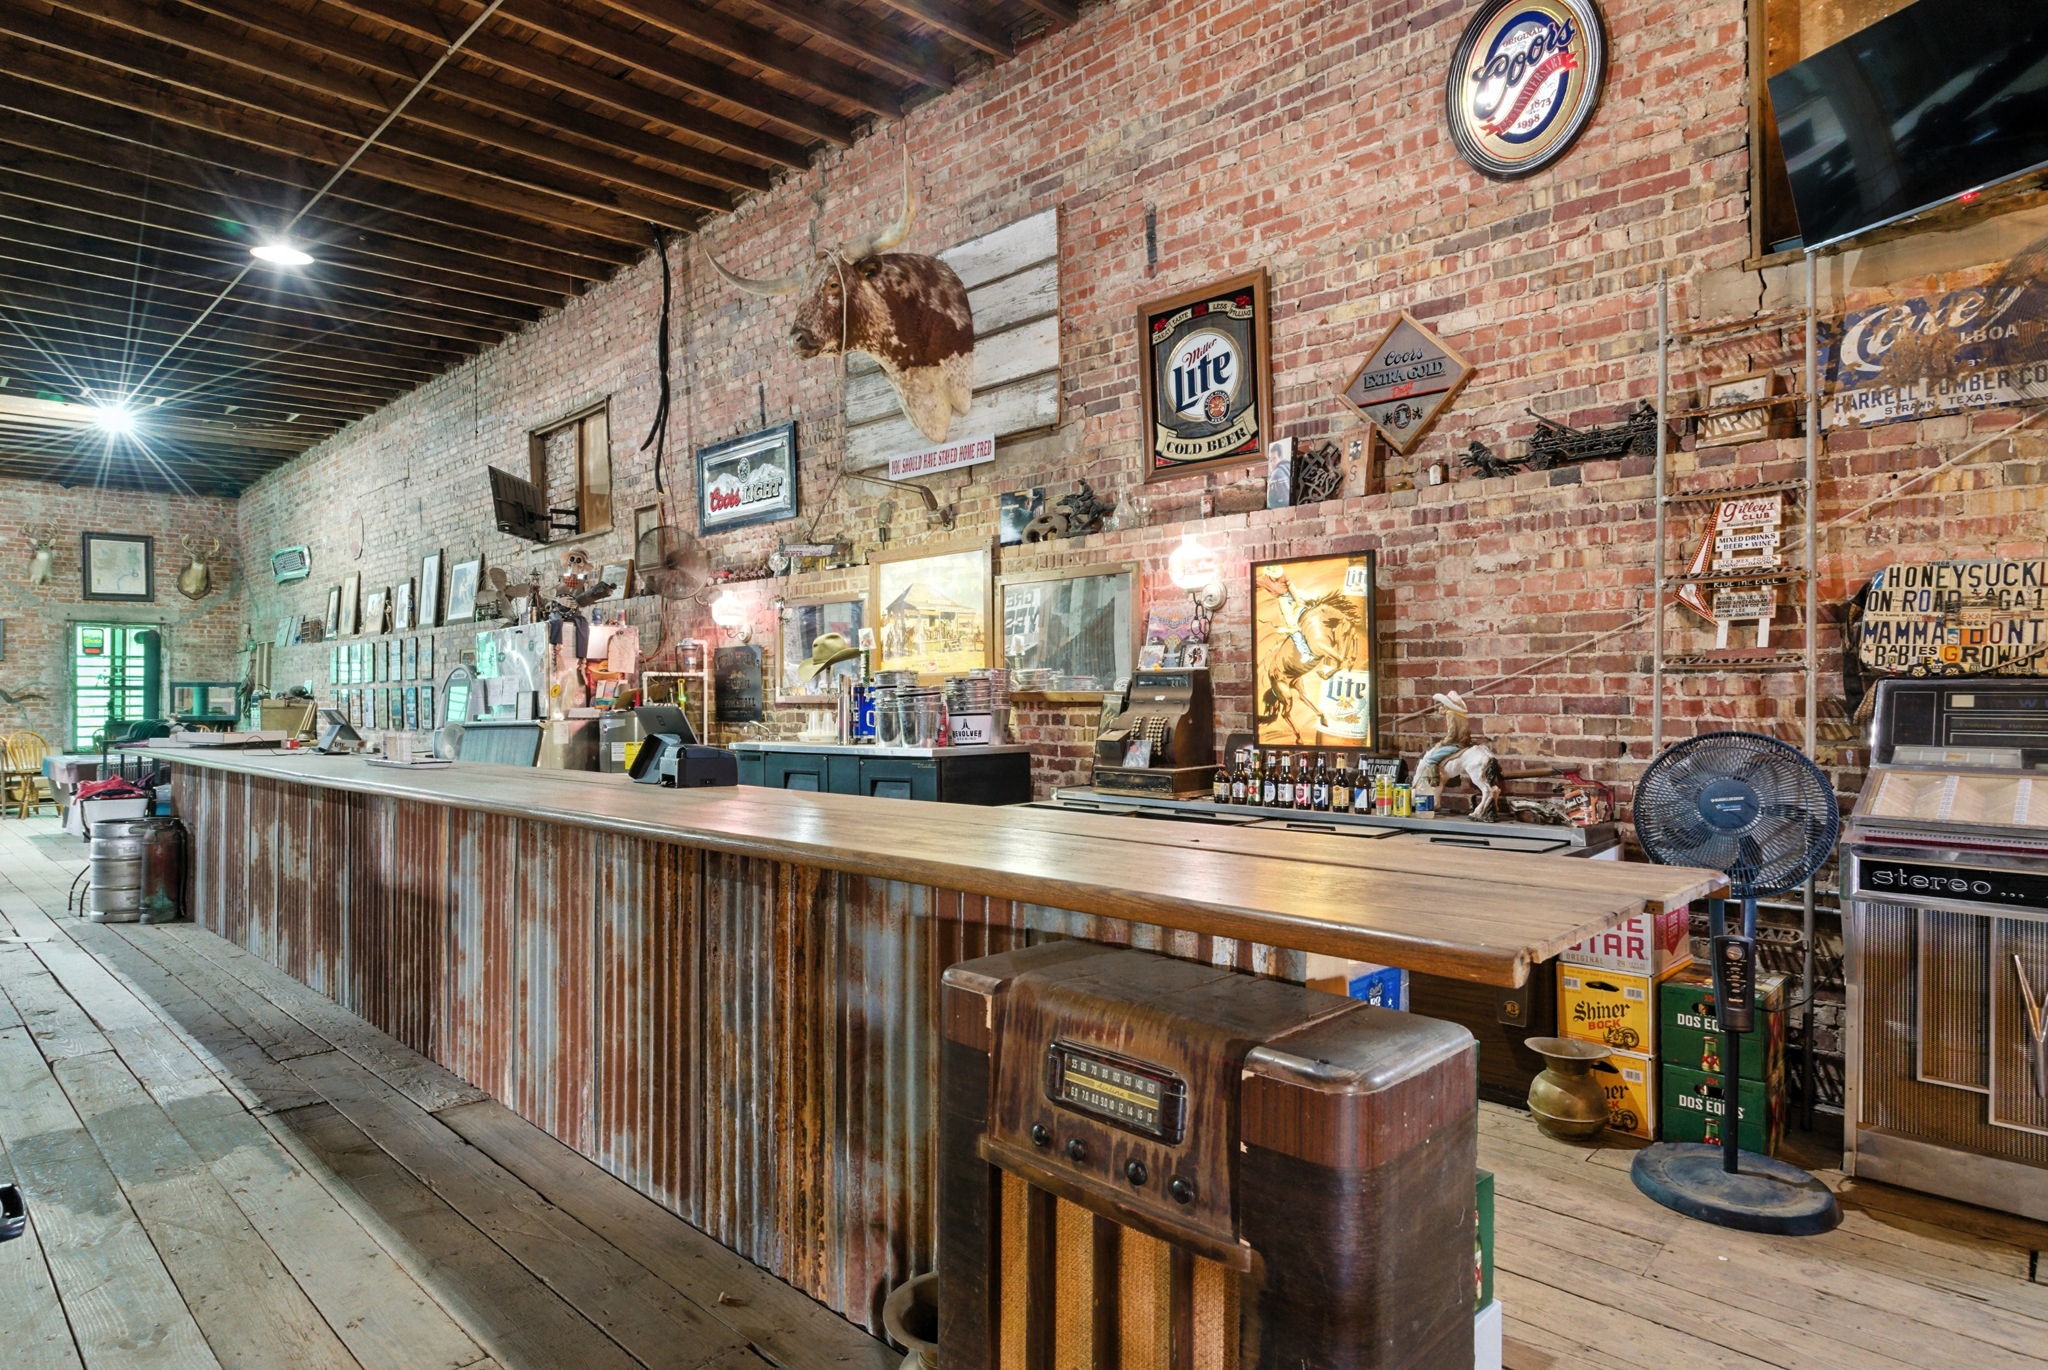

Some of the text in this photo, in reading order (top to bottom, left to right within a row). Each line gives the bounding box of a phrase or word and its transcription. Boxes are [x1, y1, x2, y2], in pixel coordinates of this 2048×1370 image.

[1503, 27, 1542, 47] ORIGINAL
[1472, 16, 1577, 119] Coors
[1517, 113, 1540, 128] 1998
[1182, 338, 1217, 368] Miller
[1383, 348, 1423, 367] Coors
[1172, 350, 1233, 413] Lite
[1363, 369, 1406, 389] EXTRA
[1835, 384, 1918, 413] HARRELL
[1926, 371, 2010, 399] LUMBER
[1166, 425, 1248, 456] COLD BEER
[891, 439, 992, 476] YOU SHOULD HAVE STAYED HOME FRED
[710, 477, 783, 512] Coors LIGHT
[1727, 520, 1754, 528] Recording
[1742, 512, 1770, 521] CLUB
[1719, 533, 1776, 544] MIXED DRINKS
[1346, 569, 1367, 588] Lit
[1889, 561, 2048, 589] HONEYSUCKL
[1868, 591, 1893, 612] ON
[1970, 619, 2044, 645] DONT
[1326, 676, 1366, 702] Lite
[1367, 764, 1397, 776] ALCOHOL
[1871, 868, 1992, 895] stereo
[1568, 933, 1645, 960] TAR
[1566, 953, 1604, 965] ORIGINAL
[1573, 1000, 1631, 1022] Shiner
[1677, 1013, 1701, 1029] DOS
[1588, 1018, 1621, 1031] BOCK
[1112, 1071, 1121, 1083] 100
[1123, 1073, 1132, 1086] 120
[1118, 1102, 1124, 1113] 12
[1127, 1105, 1134, 1116] 14
[1678, 1094, 1703, 1110] DOS
